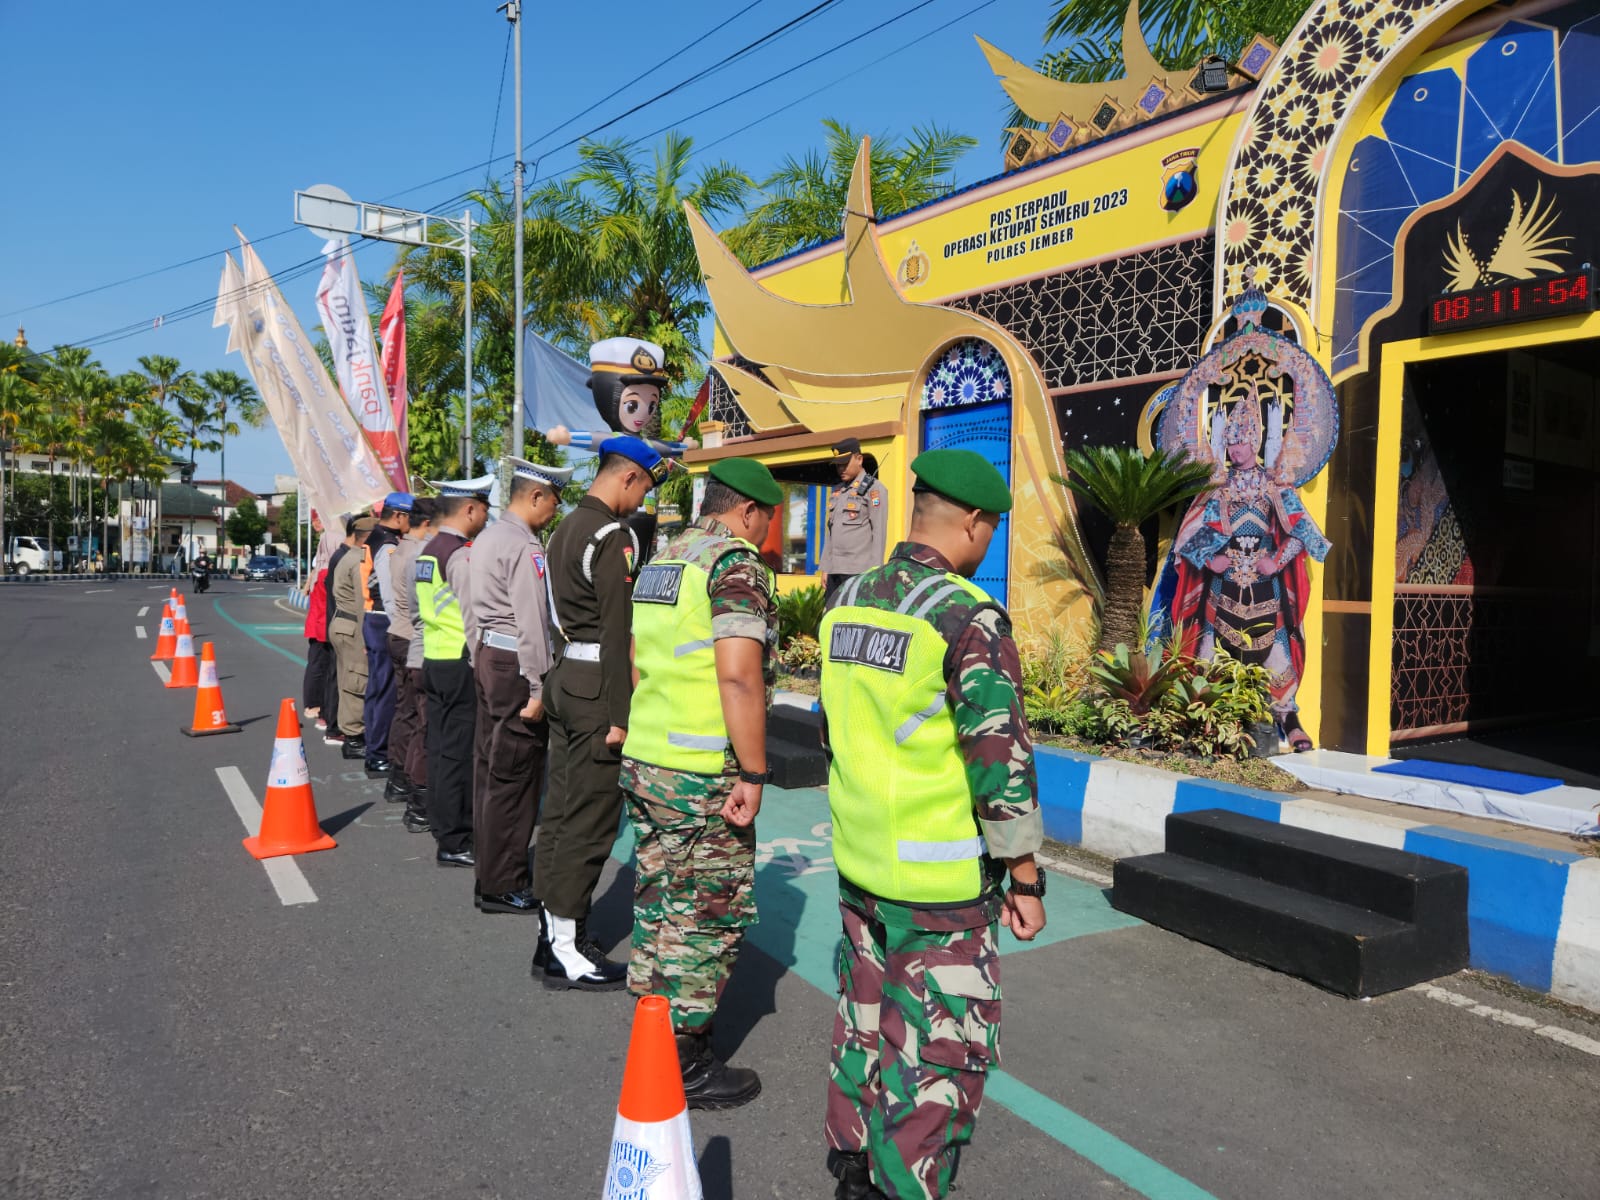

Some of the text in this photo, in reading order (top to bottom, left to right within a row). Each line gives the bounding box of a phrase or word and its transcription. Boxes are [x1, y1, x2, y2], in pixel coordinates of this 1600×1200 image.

[943, 188, 1128, 258] OPERASI KETUPAT SEMERU 2023
[990, 190, 1067, 228] POS TERPADU
[987, 227, 1074, 263] POLRES JEMBER
[866, 631, 905, 667] 0824
